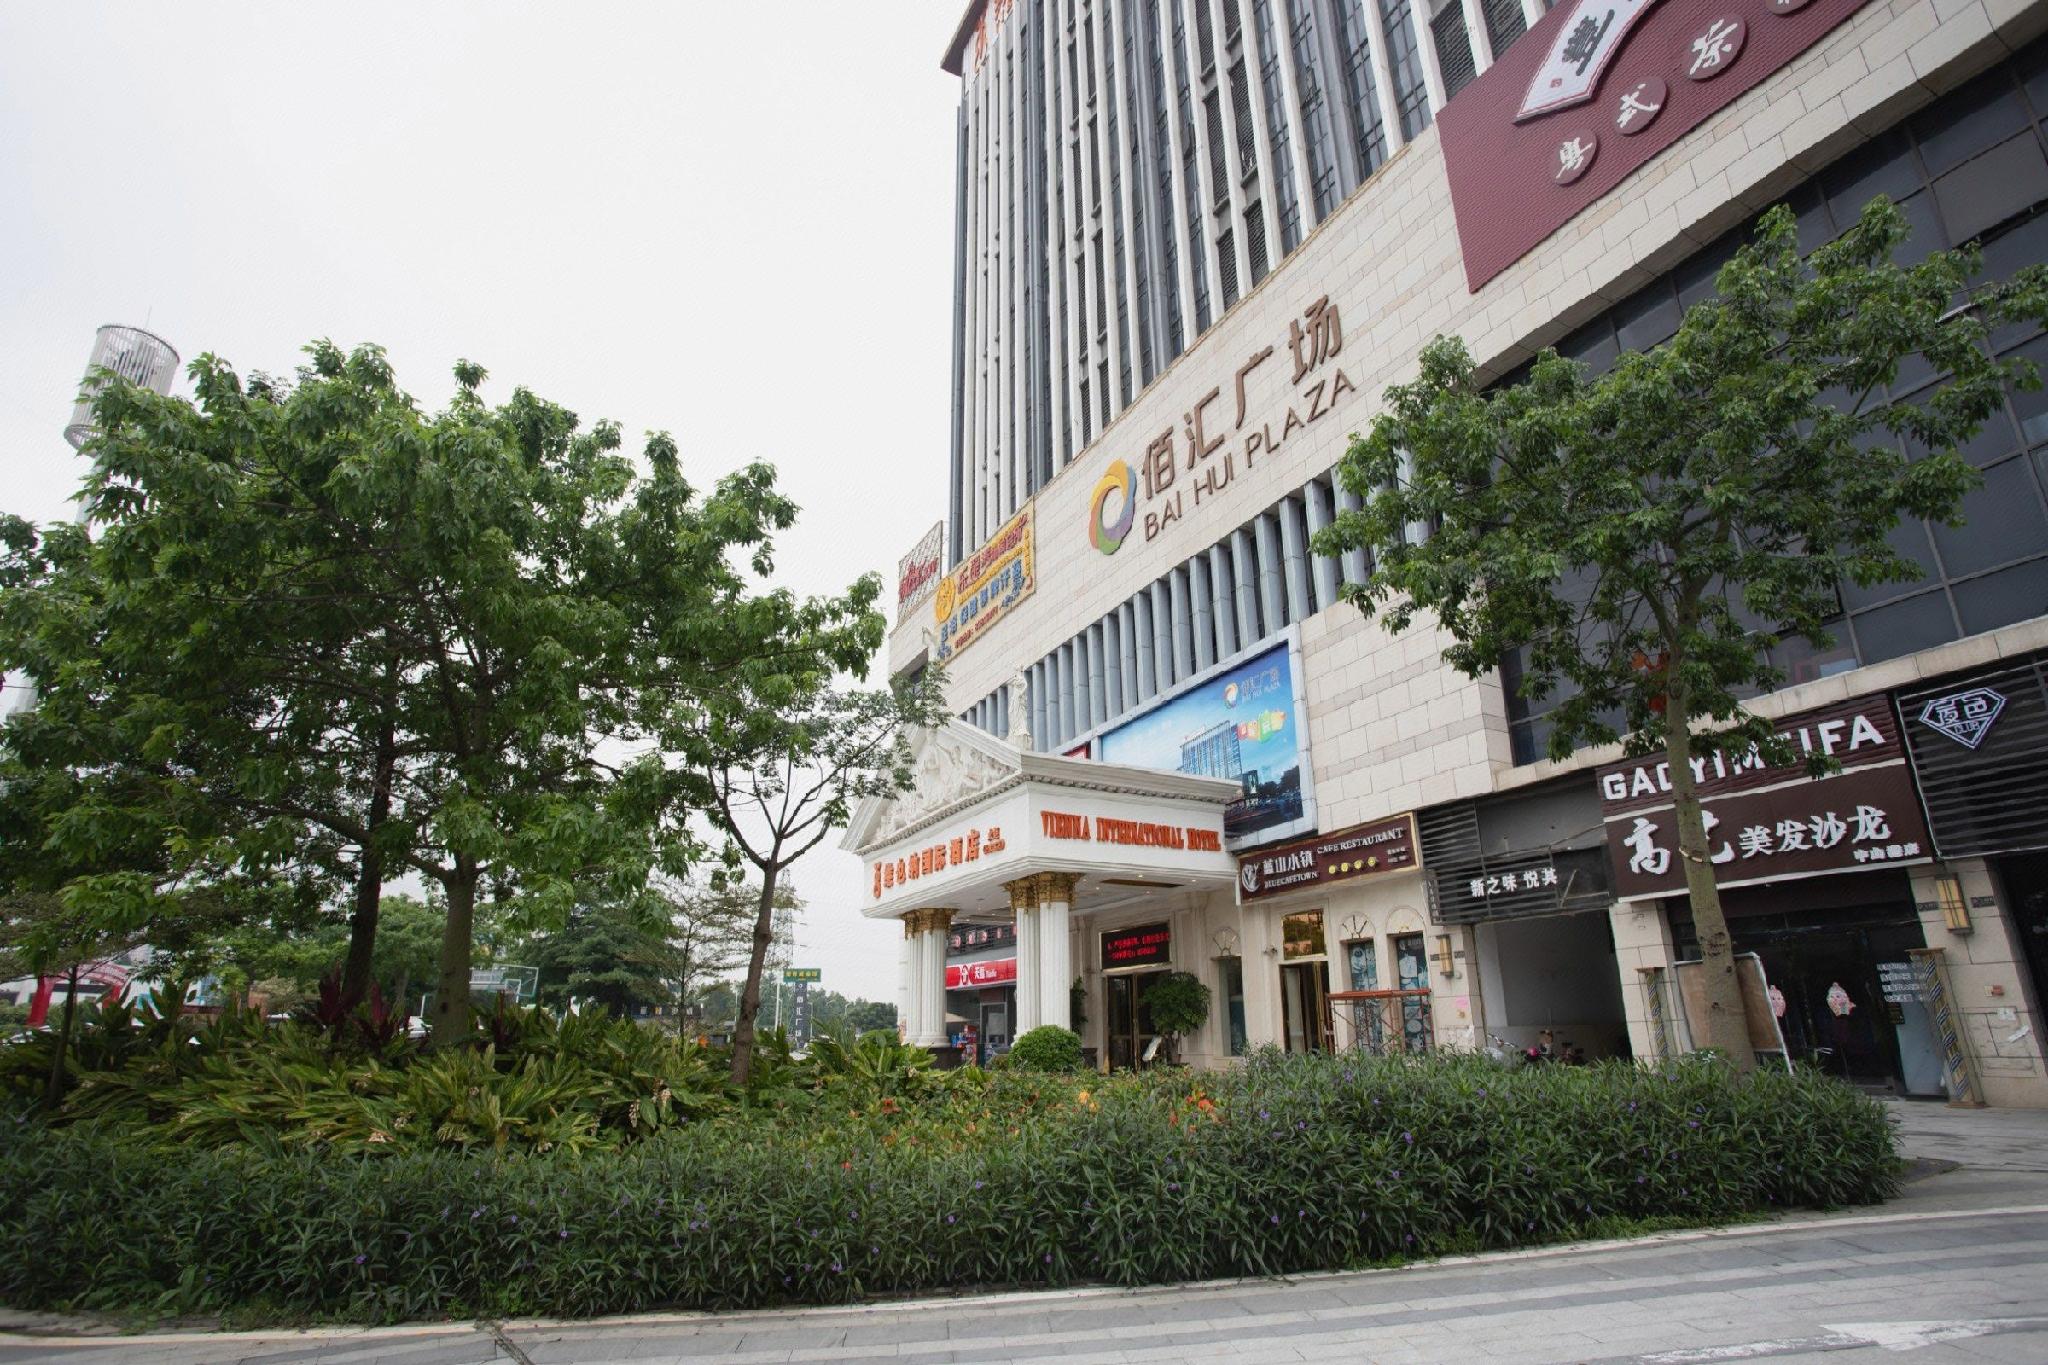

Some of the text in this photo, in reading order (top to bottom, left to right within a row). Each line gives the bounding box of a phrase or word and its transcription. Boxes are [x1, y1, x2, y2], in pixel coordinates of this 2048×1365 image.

[1142, 294, 1342, 500] 佰汇广场
[1143, 367, 1356, 542] BAI HUI PLAZA
[1040, 810, 1222, 851] VIENNA INTERNATIONAL HOTEL
[1317, 827, 1404, 855] CAFE RESTAURANT
[1738, 805, 1892, 860] 美发沙龙
